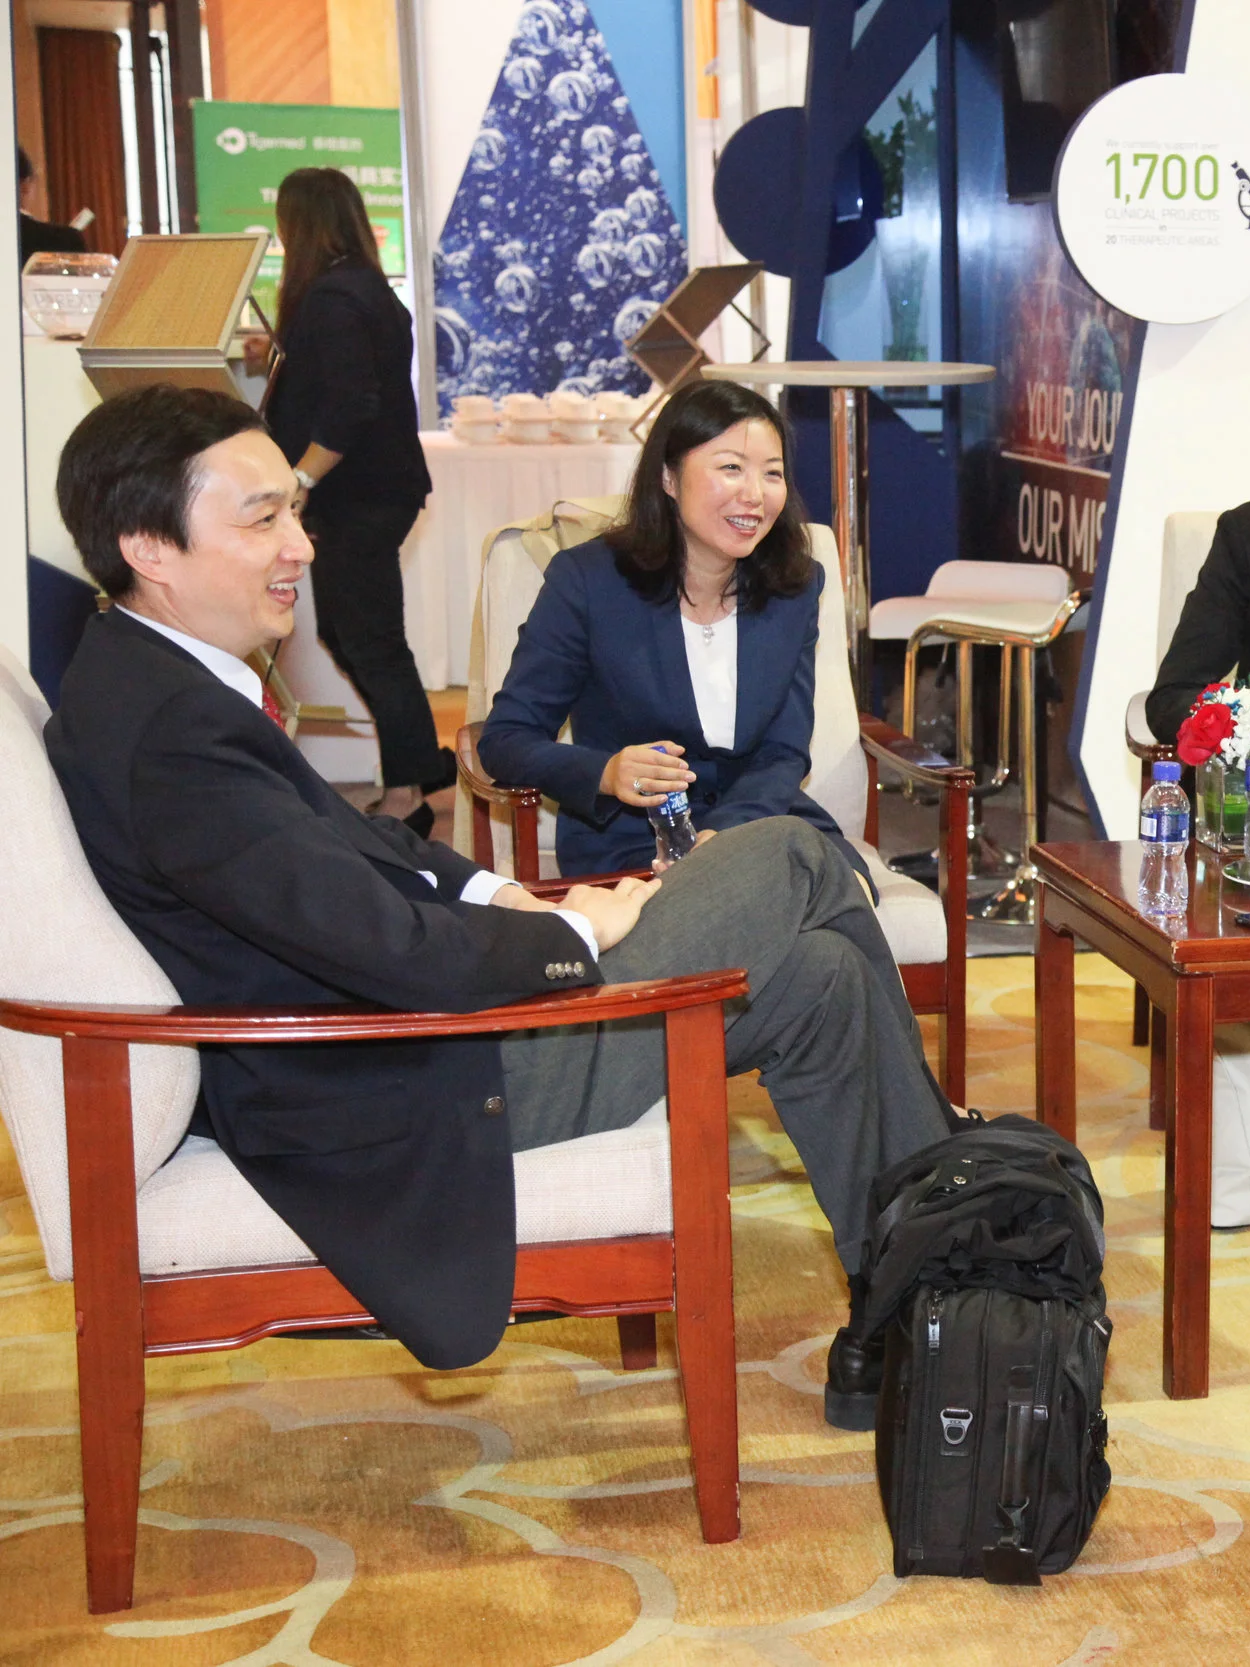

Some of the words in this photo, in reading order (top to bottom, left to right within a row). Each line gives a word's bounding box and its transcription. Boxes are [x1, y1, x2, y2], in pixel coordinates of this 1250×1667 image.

[1106, 152, 1219, 205] 1,700
[1105, 207, 1157, 221] CLINICAL
[1161, 208, 1220, 222] PROJECTS
[1105, 234, 1117, 245] 20
[1026, 380, 1075, 446] YOUR
[1018, 483, 1063, 564] OUR
